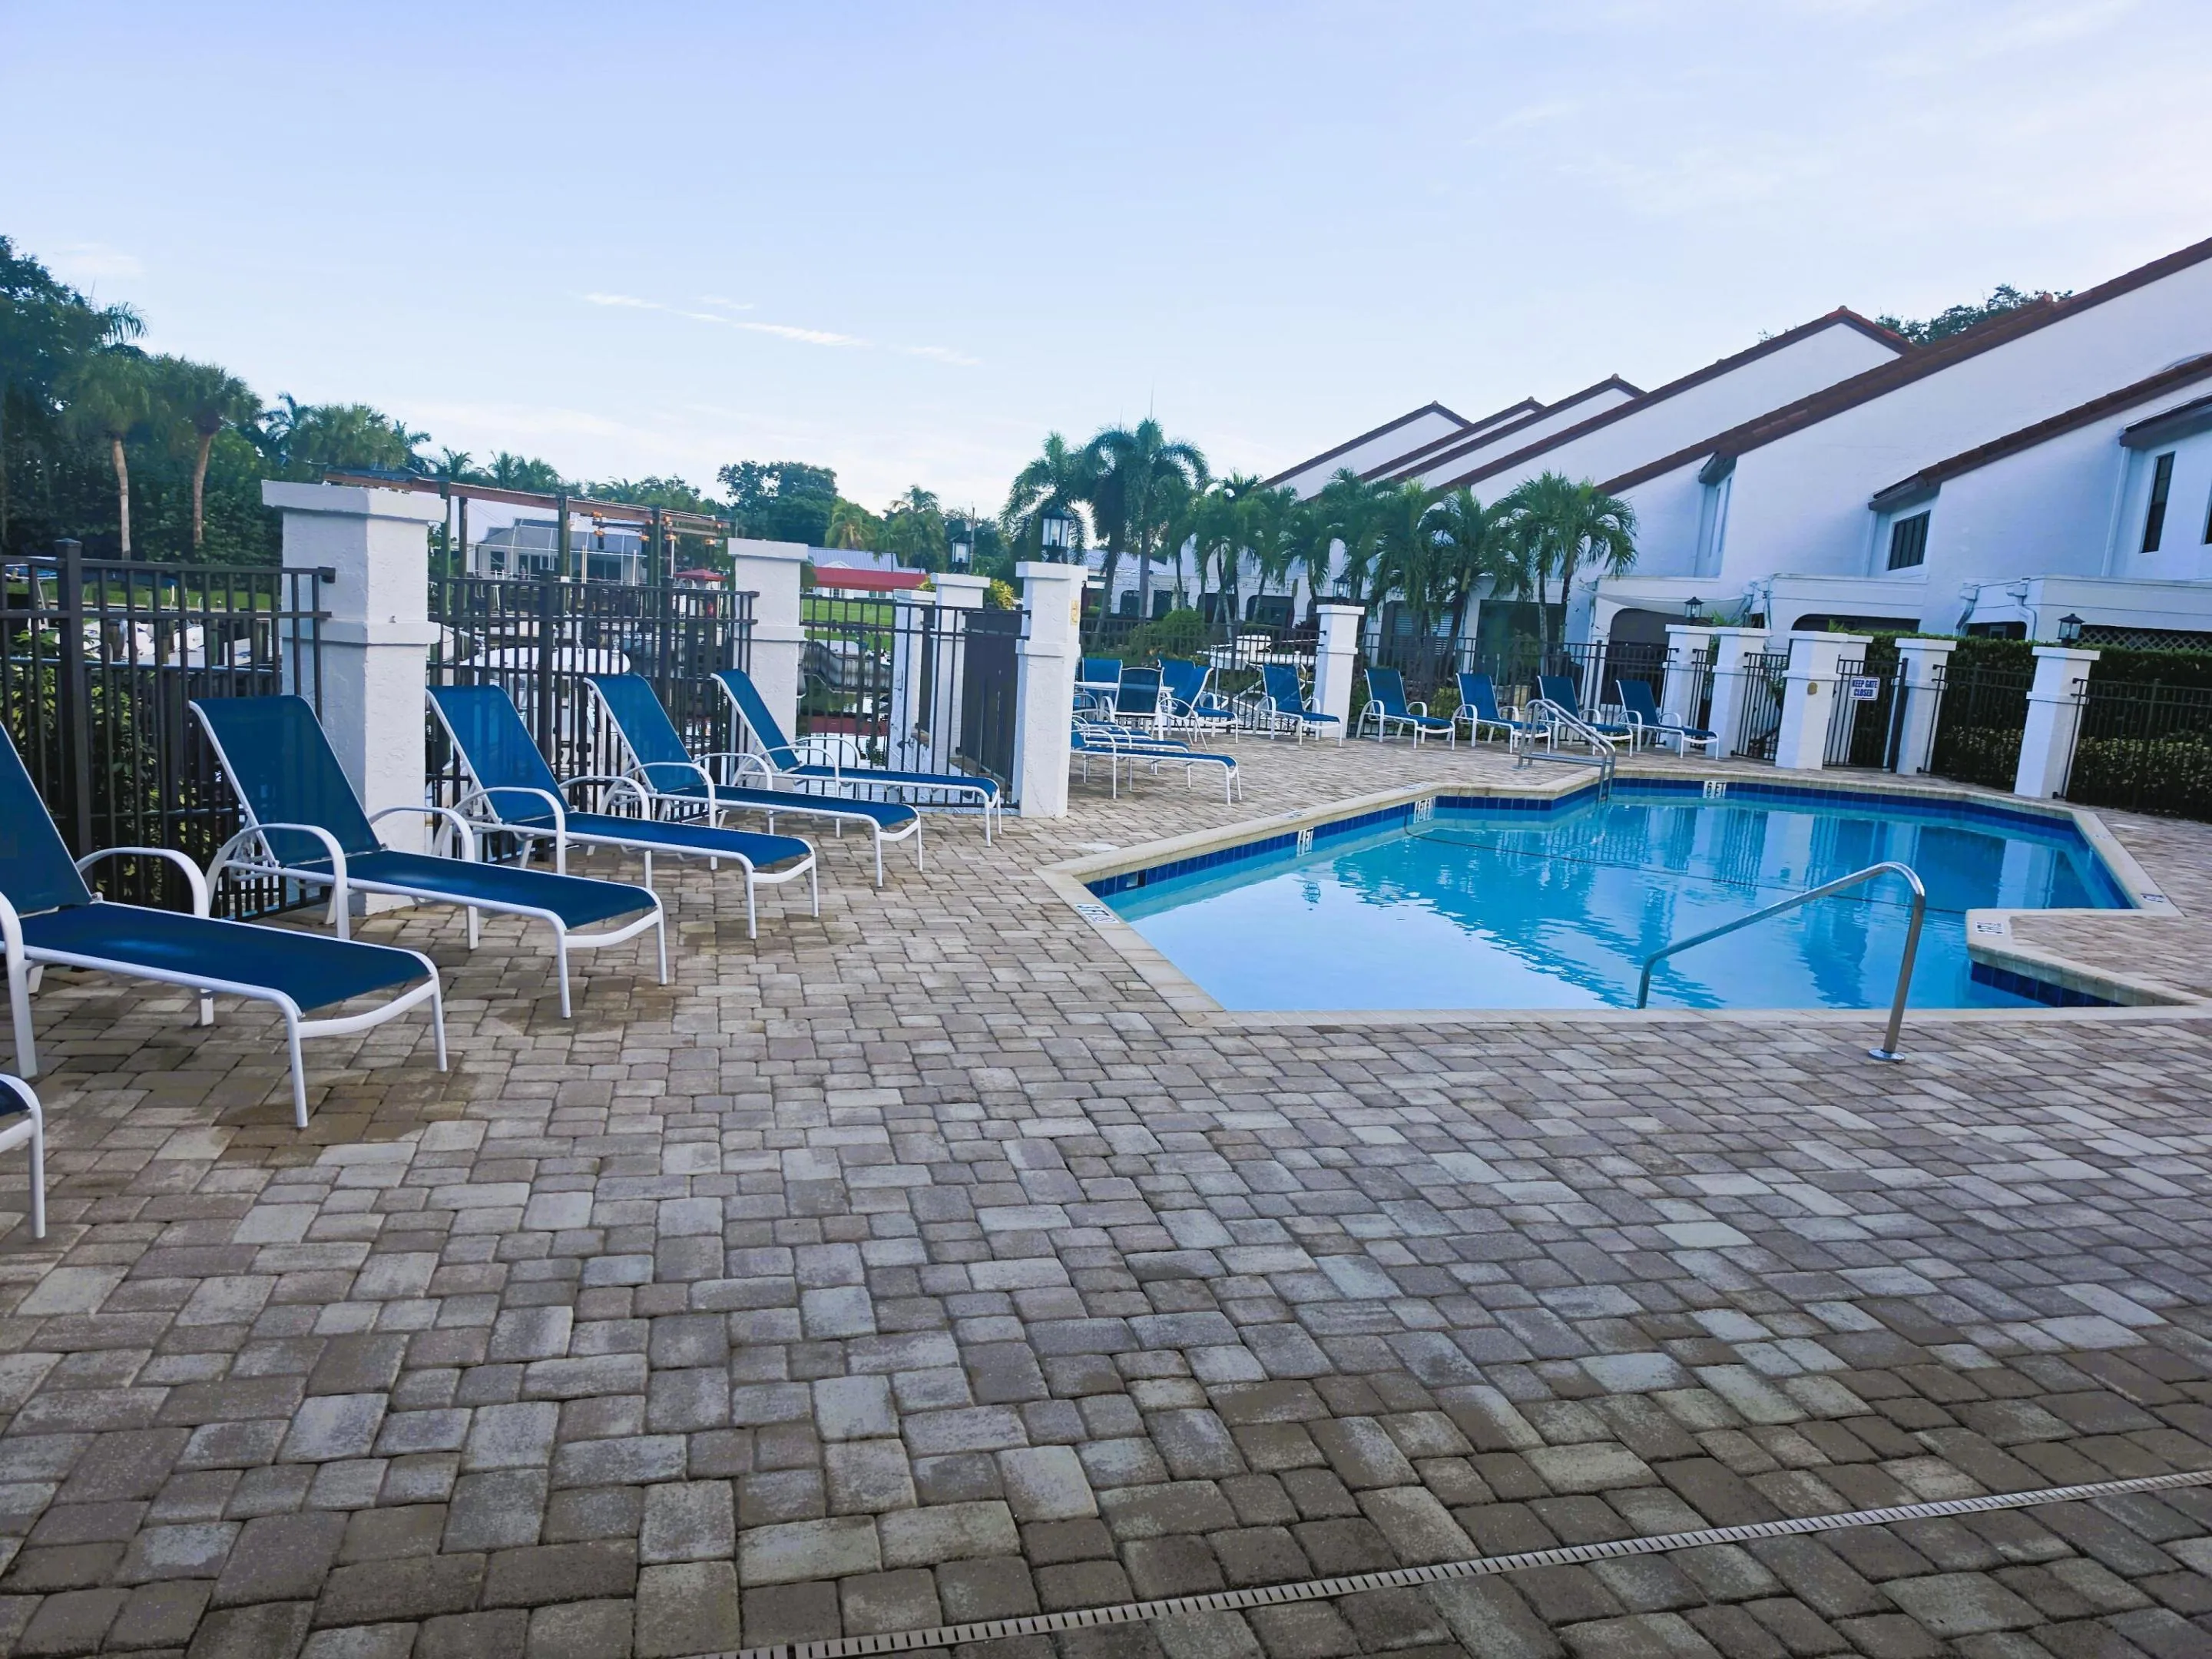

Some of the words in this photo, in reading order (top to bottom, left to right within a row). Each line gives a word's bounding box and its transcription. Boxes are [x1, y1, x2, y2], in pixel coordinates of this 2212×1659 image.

[1852, 679, 1865, 687] KEEP
[1865, 680, 1878, 688] GATE
[1853, 688, 1873, 697] CLOSED
[1706, 781, 1713, 798] 6
[1714, 782, 1726, 797] FT
